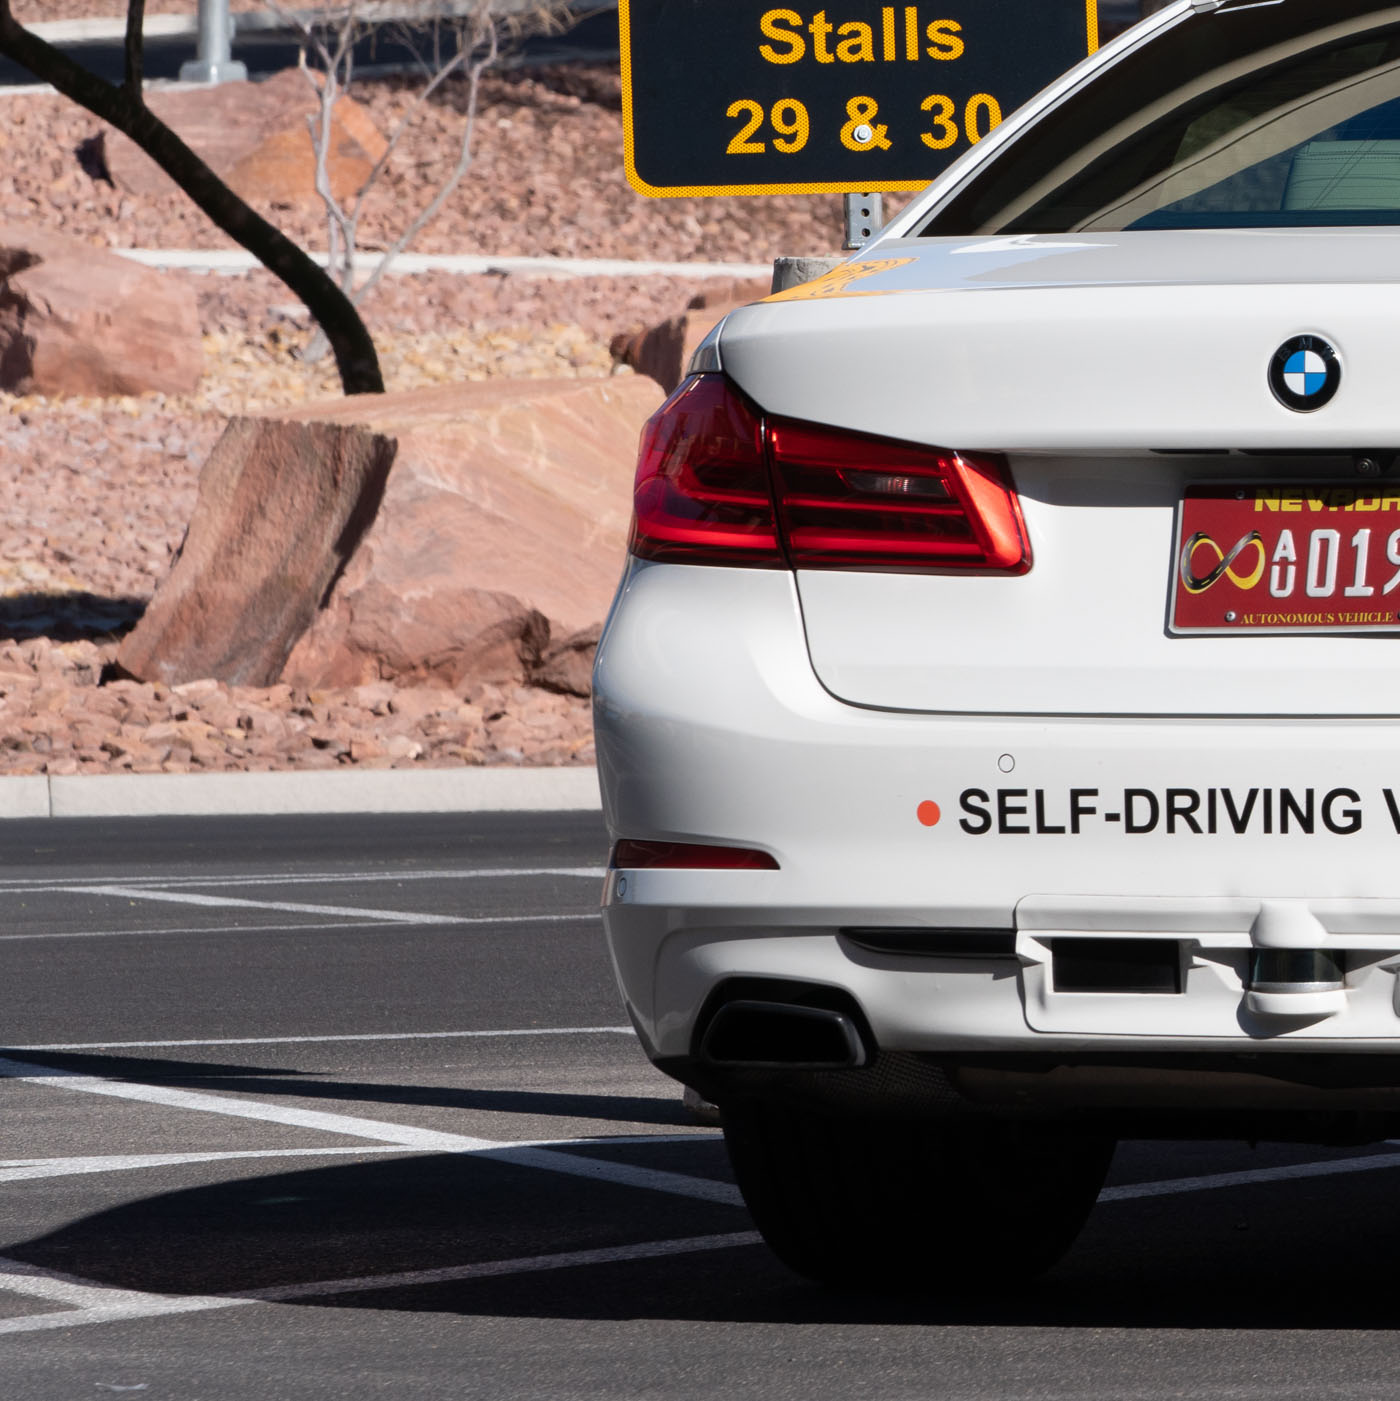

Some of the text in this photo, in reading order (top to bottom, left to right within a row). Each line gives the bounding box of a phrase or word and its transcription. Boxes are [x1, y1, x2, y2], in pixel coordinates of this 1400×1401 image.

[758, 6, 965, 65] Stalls
[725, 92, 1003, 155] 29 & 30
[1241, 611, 1394, 624] AUTONOMOUS VEHICLE
[958, 787, 1362, 835] SELF-DRIVING
